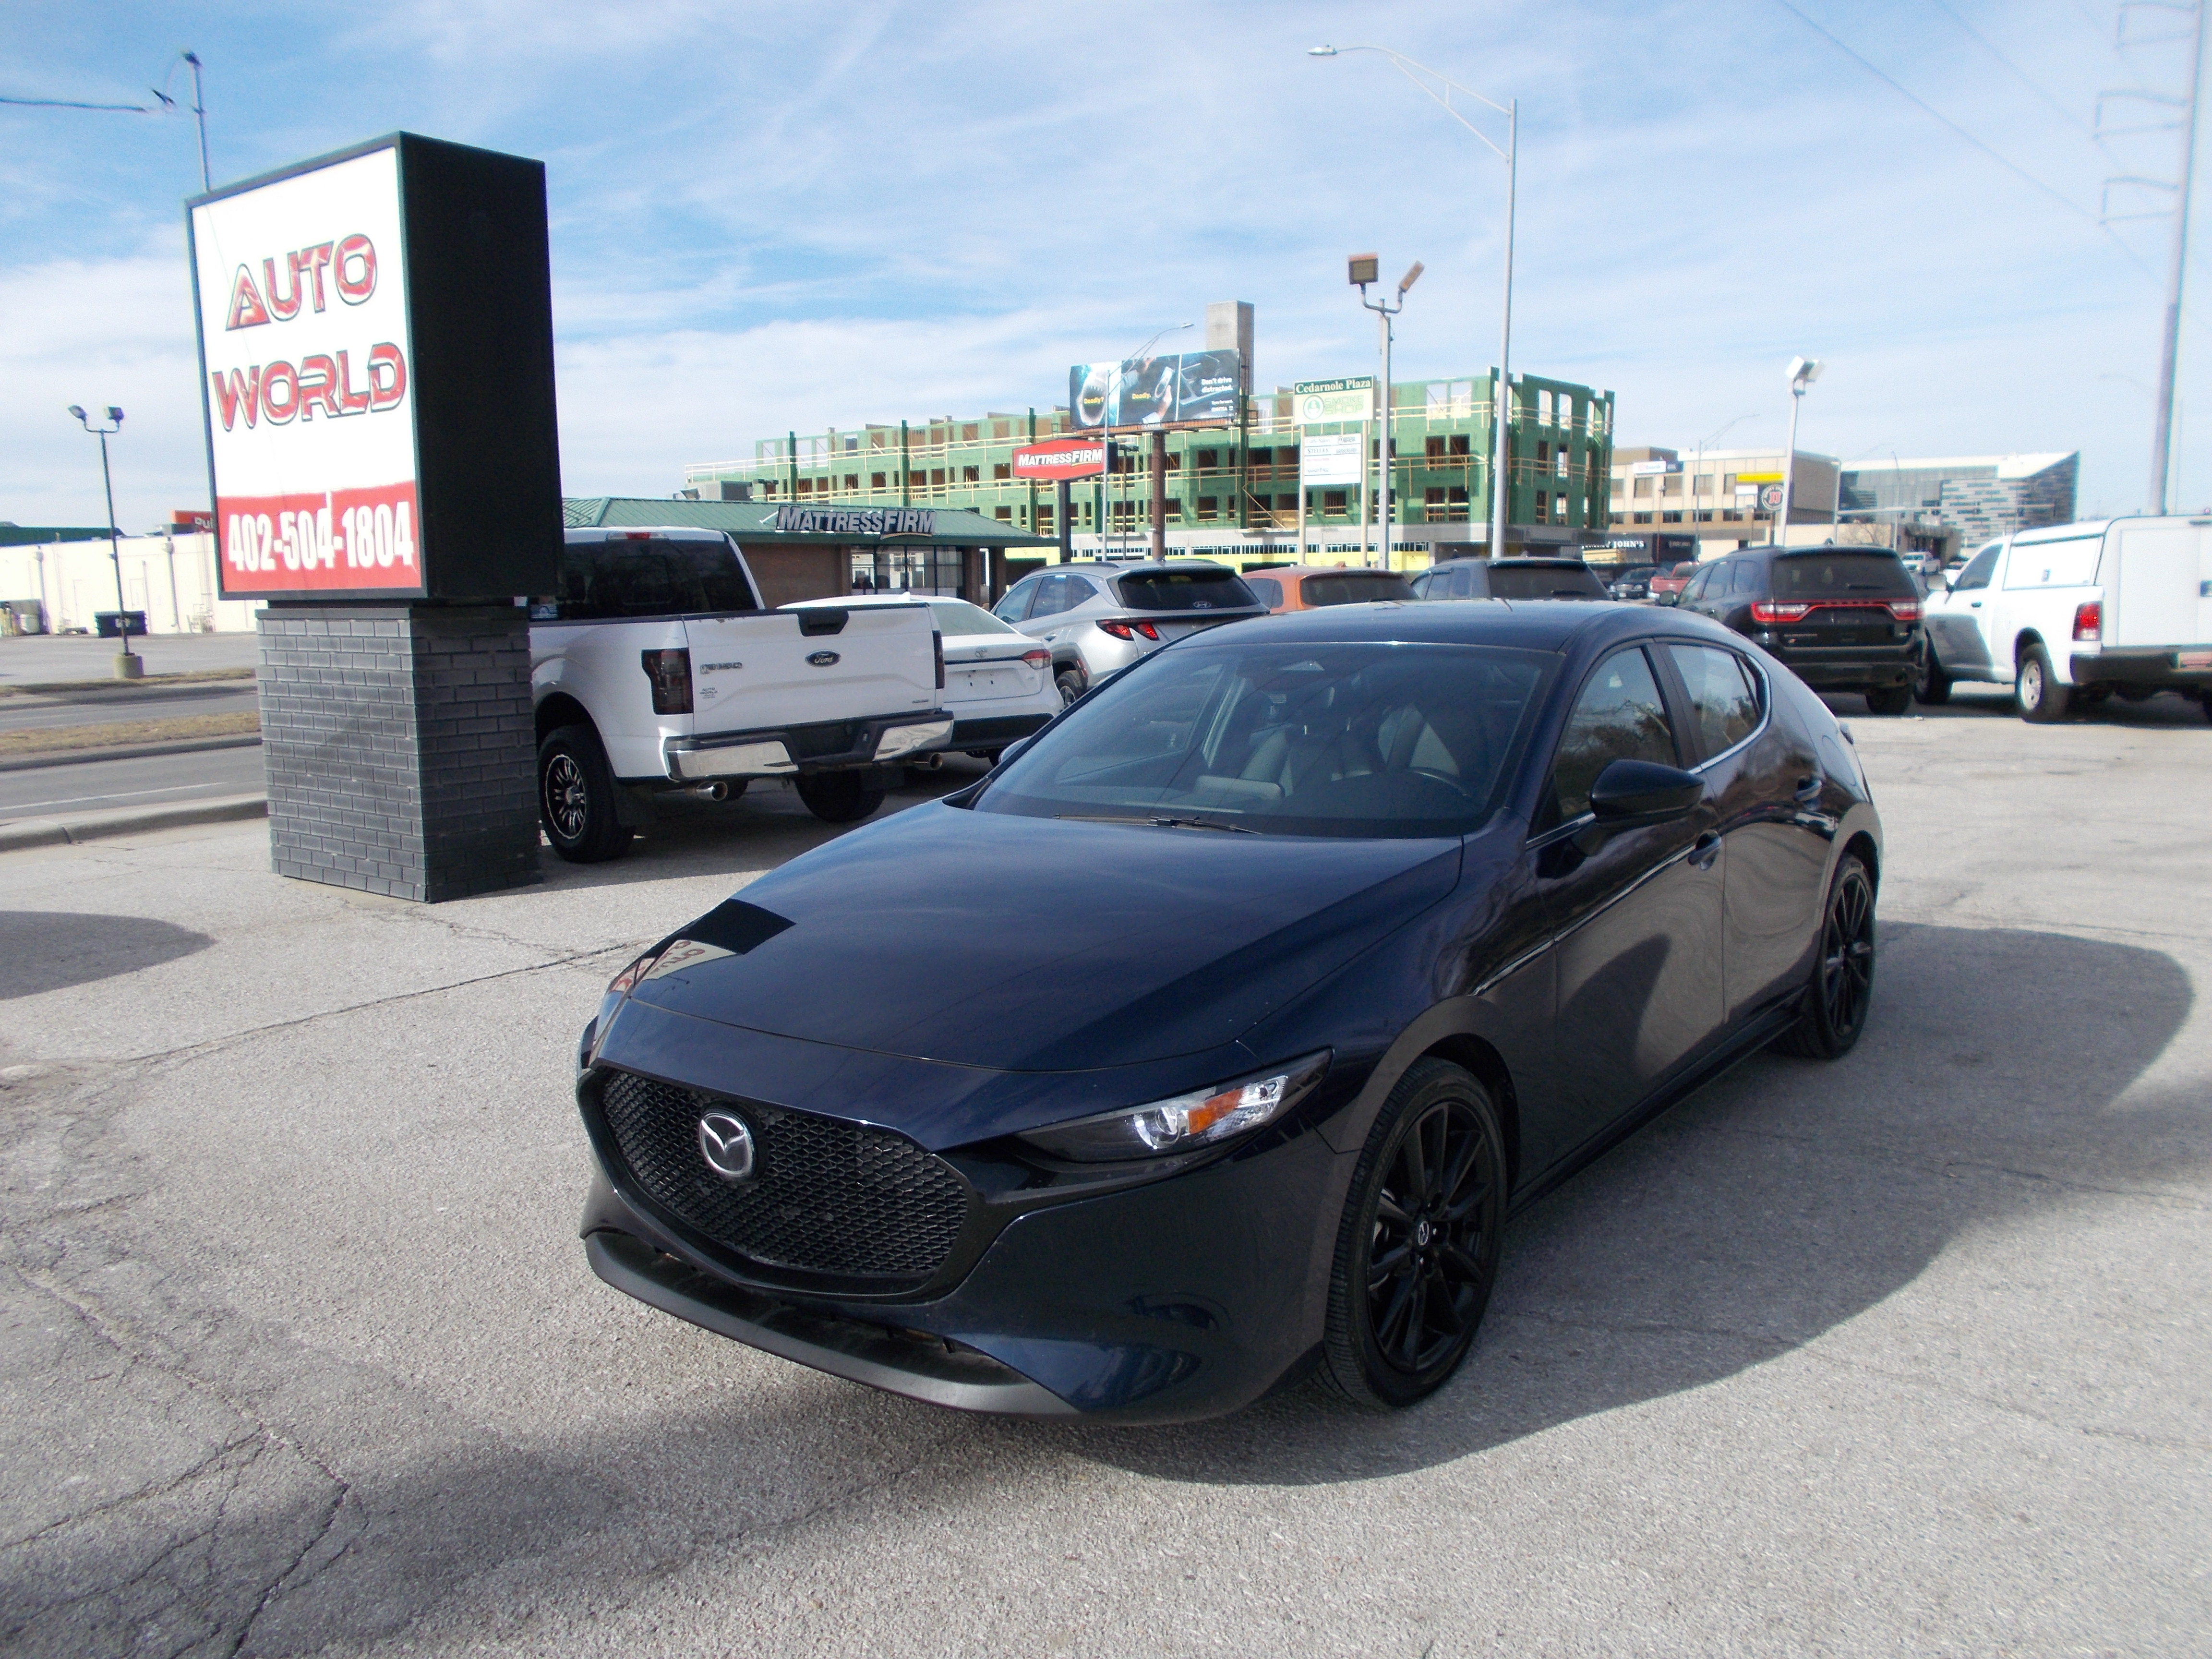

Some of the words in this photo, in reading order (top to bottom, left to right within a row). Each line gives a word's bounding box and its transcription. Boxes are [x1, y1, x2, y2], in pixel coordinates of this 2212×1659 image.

[226, 233, 378, 331] AUTO
[212, 342, 407, 432] WORLD
[1296, 381, 1344, 393] Cedarnole
[1346, 379, 1370, 389] Plaza
[1084, 397, 1105, 405] Deadly?
[1324, 395, 1364, 405] SMOKE
[1324, 404, 1364, 415] SHOP
[228, 500, 415, 572] 402-504-1804
[1613, 540, 1645, 548] JOHN'S
[814, 653, 834, 664] Ford
